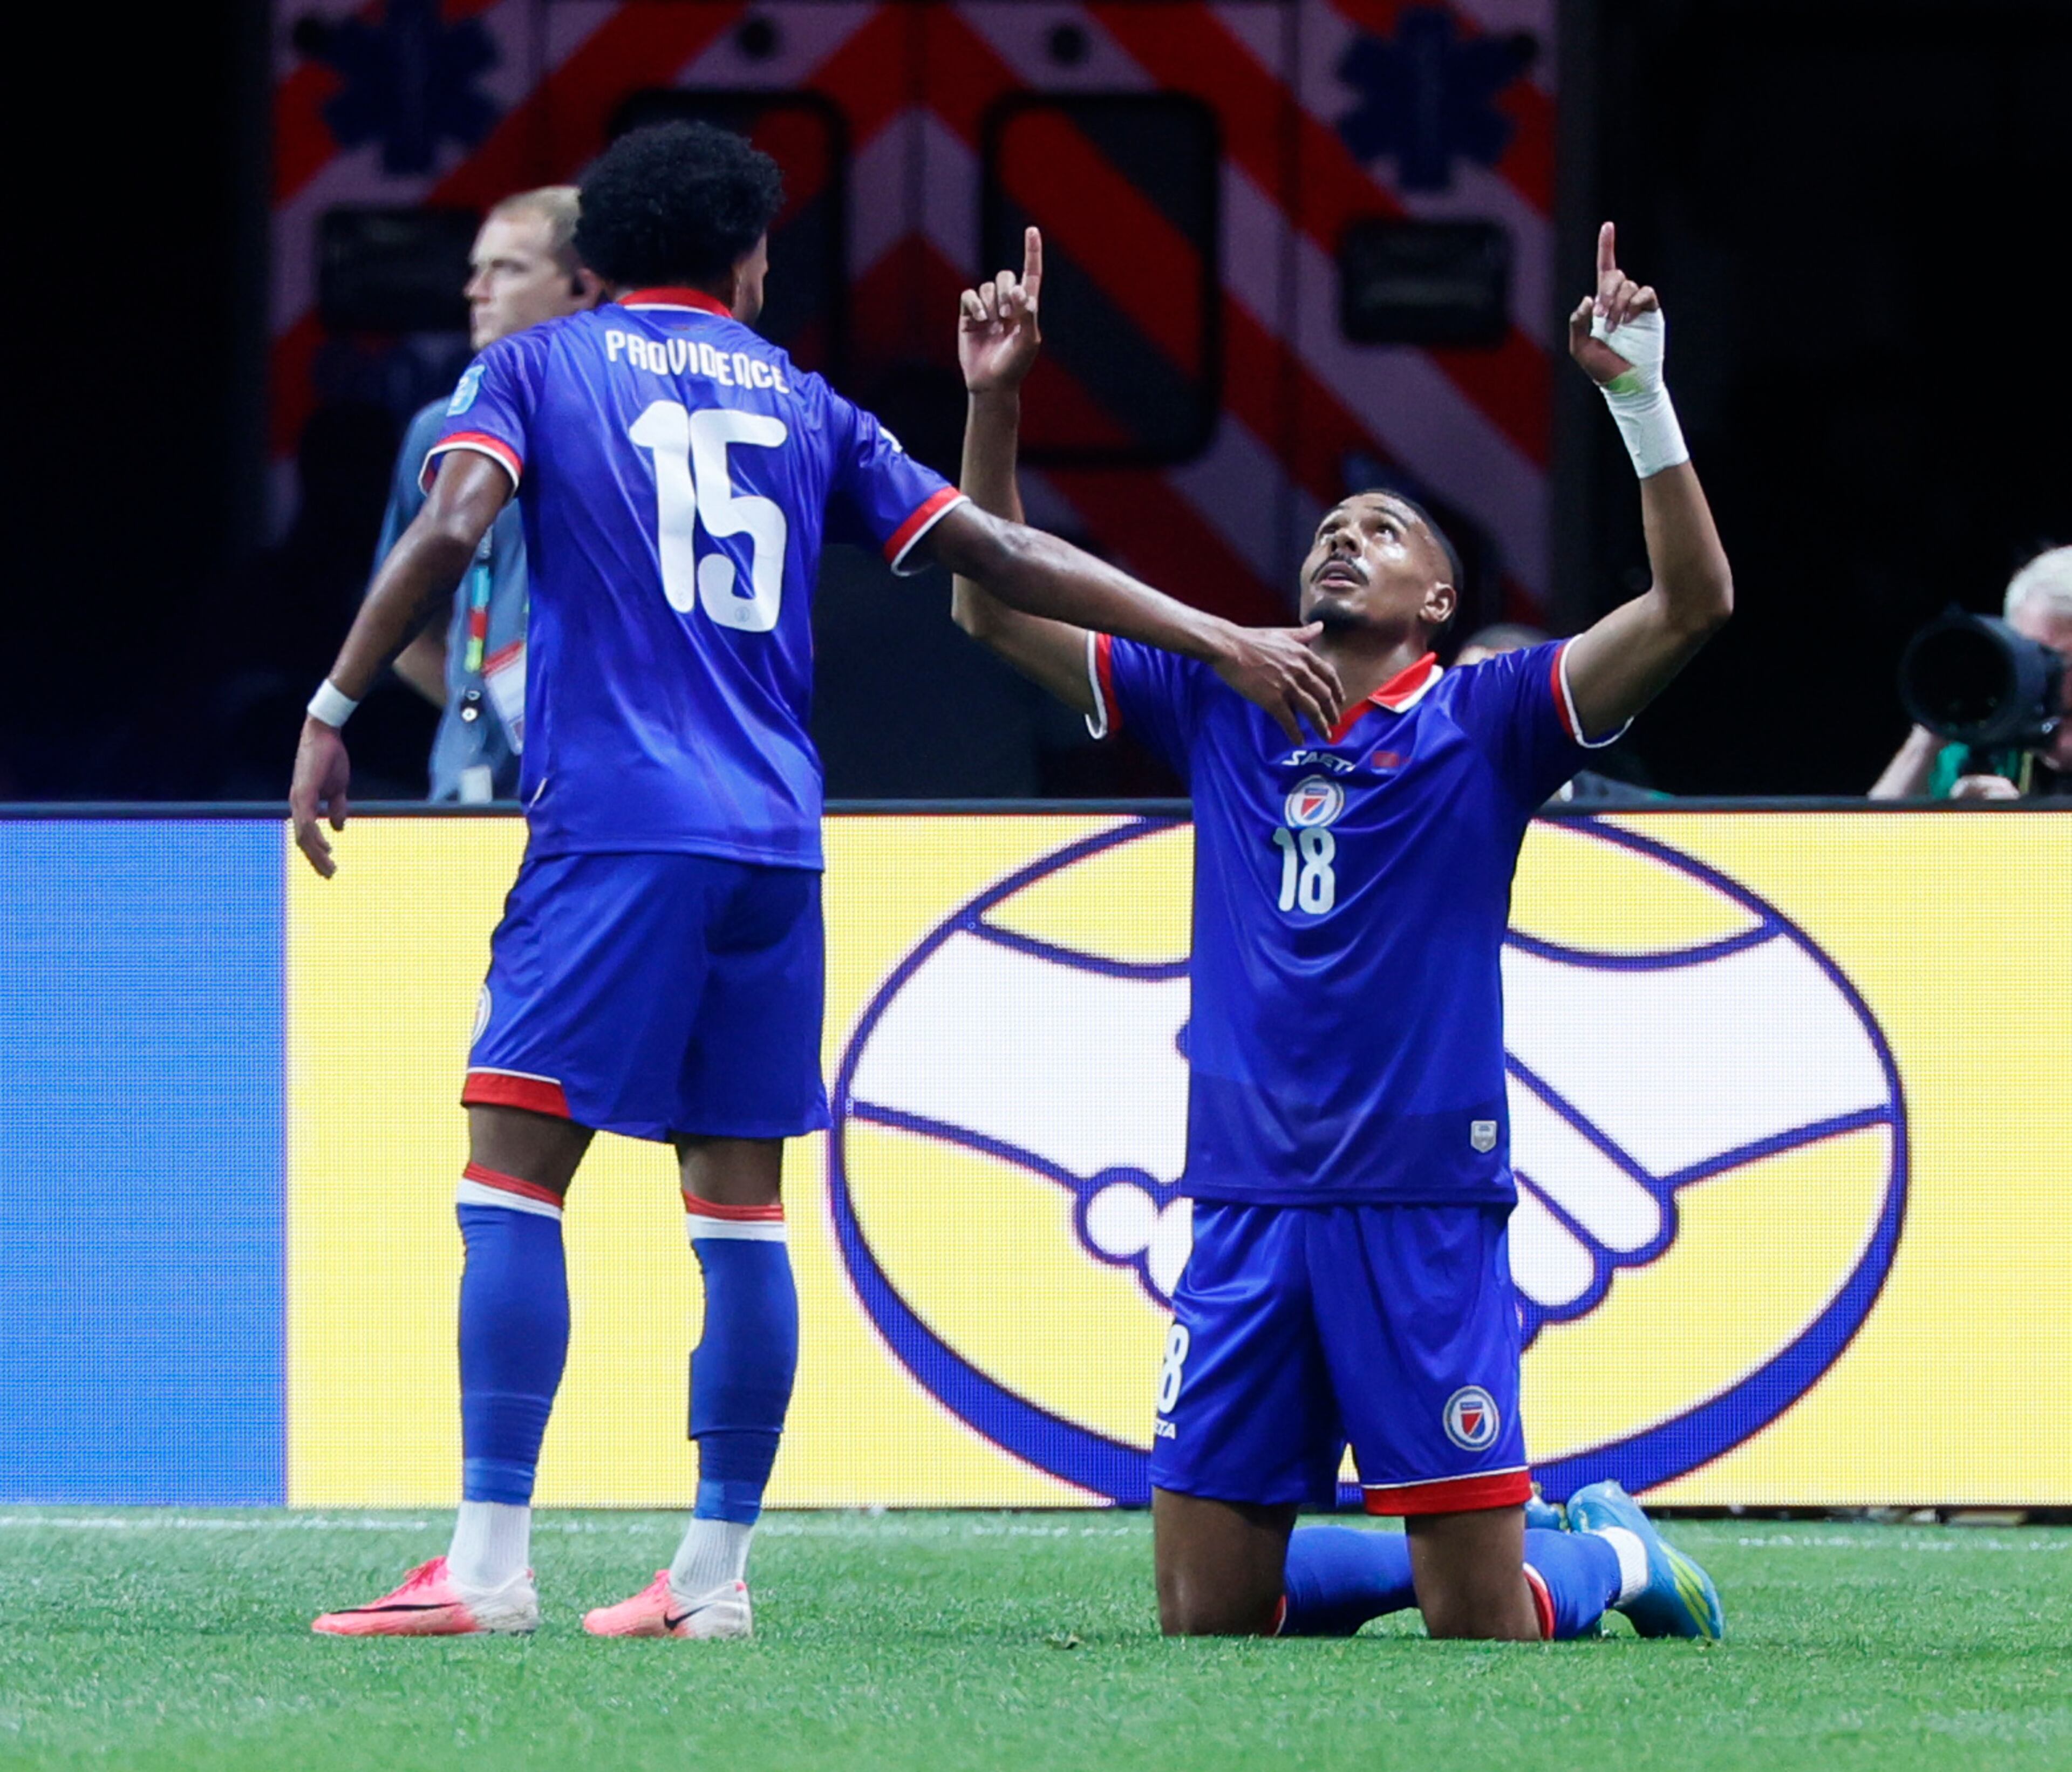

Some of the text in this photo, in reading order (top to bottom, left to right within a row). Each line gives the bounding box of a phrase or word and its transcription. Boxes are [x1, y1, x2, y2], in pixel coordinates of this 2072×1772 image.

[605, 330, 790, 394] PROVIDENCE
[629, 401, 787, 632] 15
[1273, 827, 1335, 914] 18
